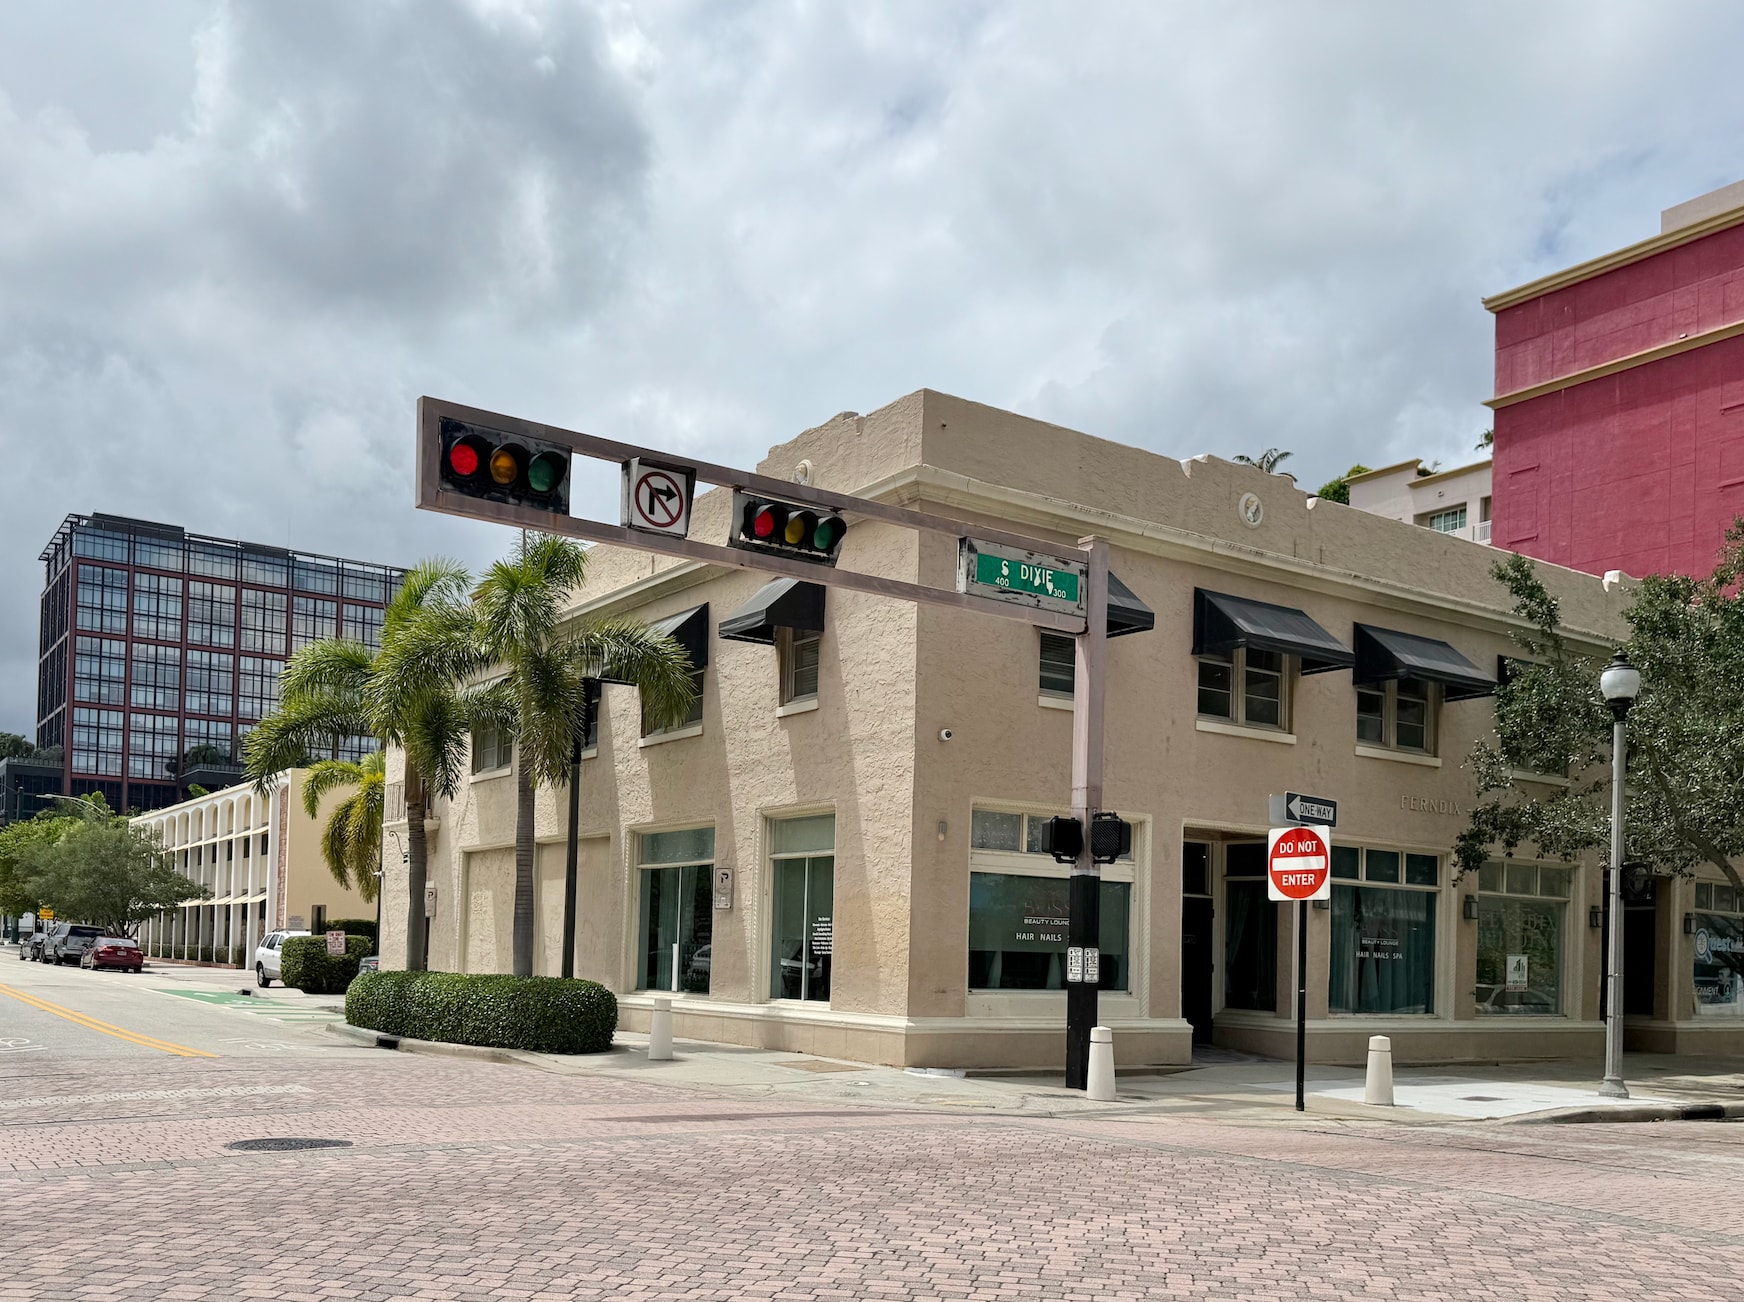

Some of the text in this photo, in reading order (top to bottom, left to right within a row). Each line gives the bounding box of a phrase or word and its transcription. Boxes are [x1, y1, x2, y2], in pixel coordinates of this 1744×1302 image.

[1001, 560, 1054, 588] S DIXIE
[995, 577, 1009, 587] 400
[1053, 588, 1066, 599] 300
[1300, 803, 1332, 819] ONE WAY
[1401, 795, 1460, 816] FERNDIX
[1279, 840, 1317, 854] DO NOT
[1282, 874, 1315, 886] ENTER
[1016, 932, 1035, 940] HAIR
[1040, 933, 1062, 942] NAILS
[1392, 952, 1403, 960] SPA
